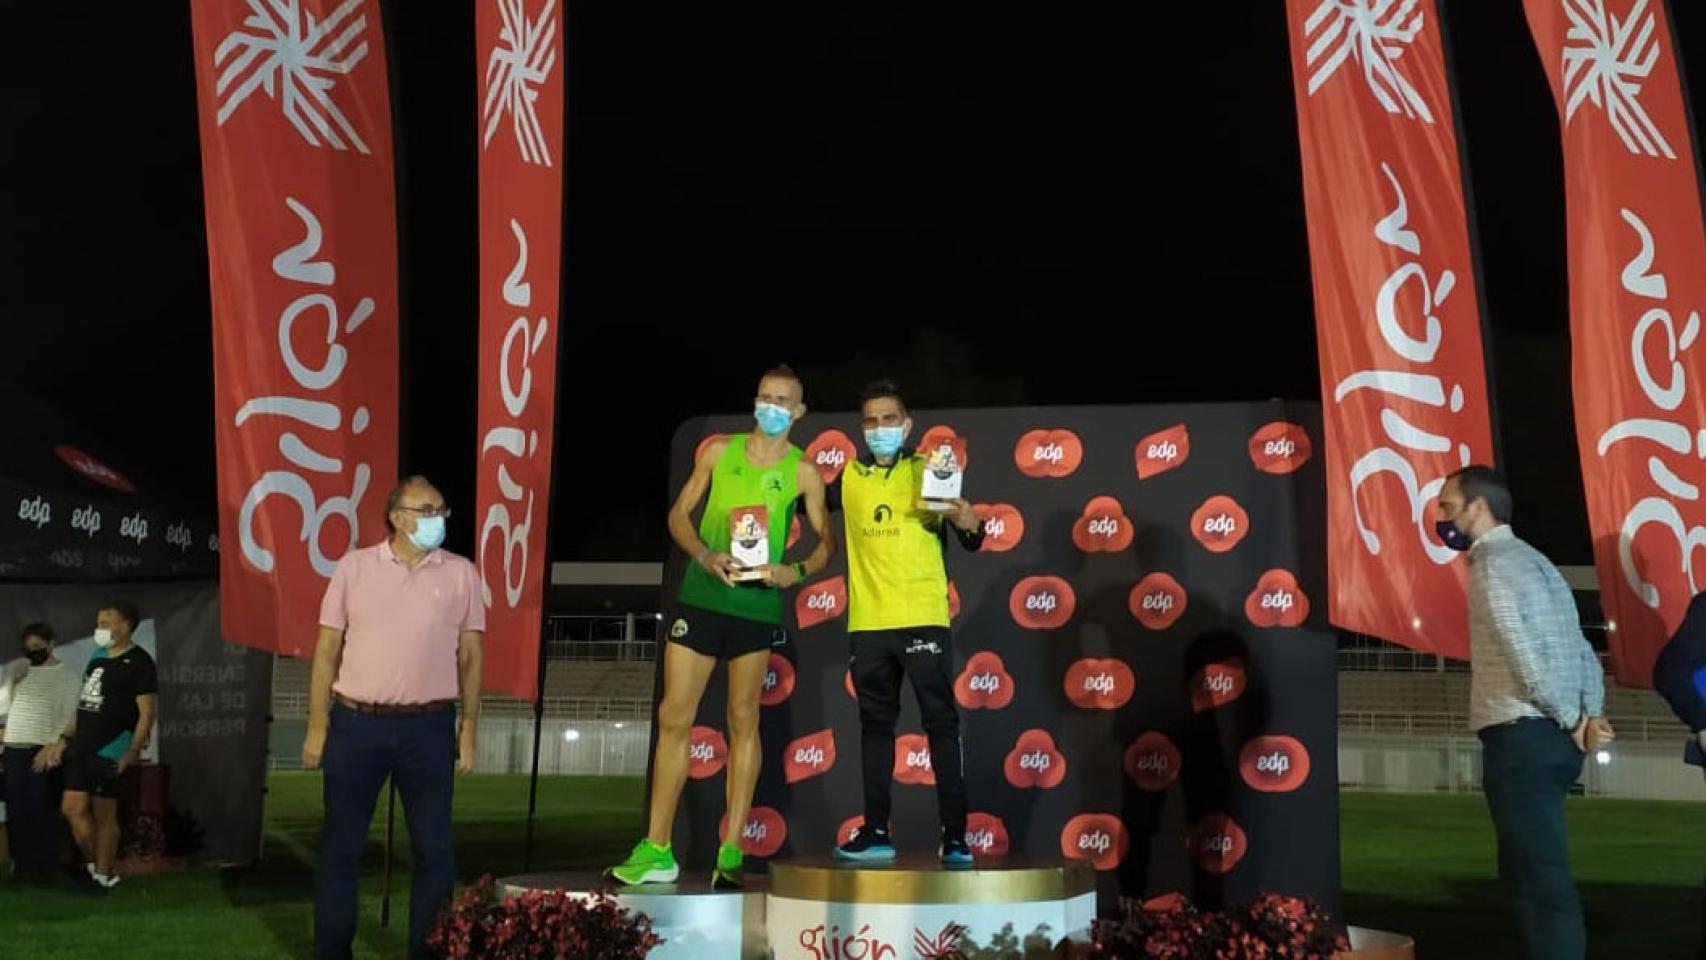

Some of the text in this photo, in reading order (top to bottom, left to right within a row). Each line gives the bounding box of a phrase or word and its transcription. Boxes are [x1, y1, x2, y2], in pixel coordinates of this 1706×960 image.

[1032, 442, 1064, 465] edp
[1146, 439, 1177, 461] edp
[1263, 436, 1295, 459] edp
[815, 447, 845, 473] edp
[17, 495, 51, 529] edp
[70, 504, 101, 537] edp
[119, 513, 148, 545] edp
[984, 516, 1005, 539] dp
[1087, 516, 1118, 539] edp
[1203, 513, 1236, 536] edp
[807, 590, 836, 613] edp
[1025, 591, 1056, 613] edp
[1142, 592, 1174, 613] edp
[1261, 588, 1293, 613] edp
[968, 671, 1000, 695] edp
[1083, 671, 1114, 695] edp
[794, 744, 824, 768] edp
[1019, 750, 1051, 773] edp
[1256, 751, 1290, 776] edp
[1078, 830, 1110, 854] edp
